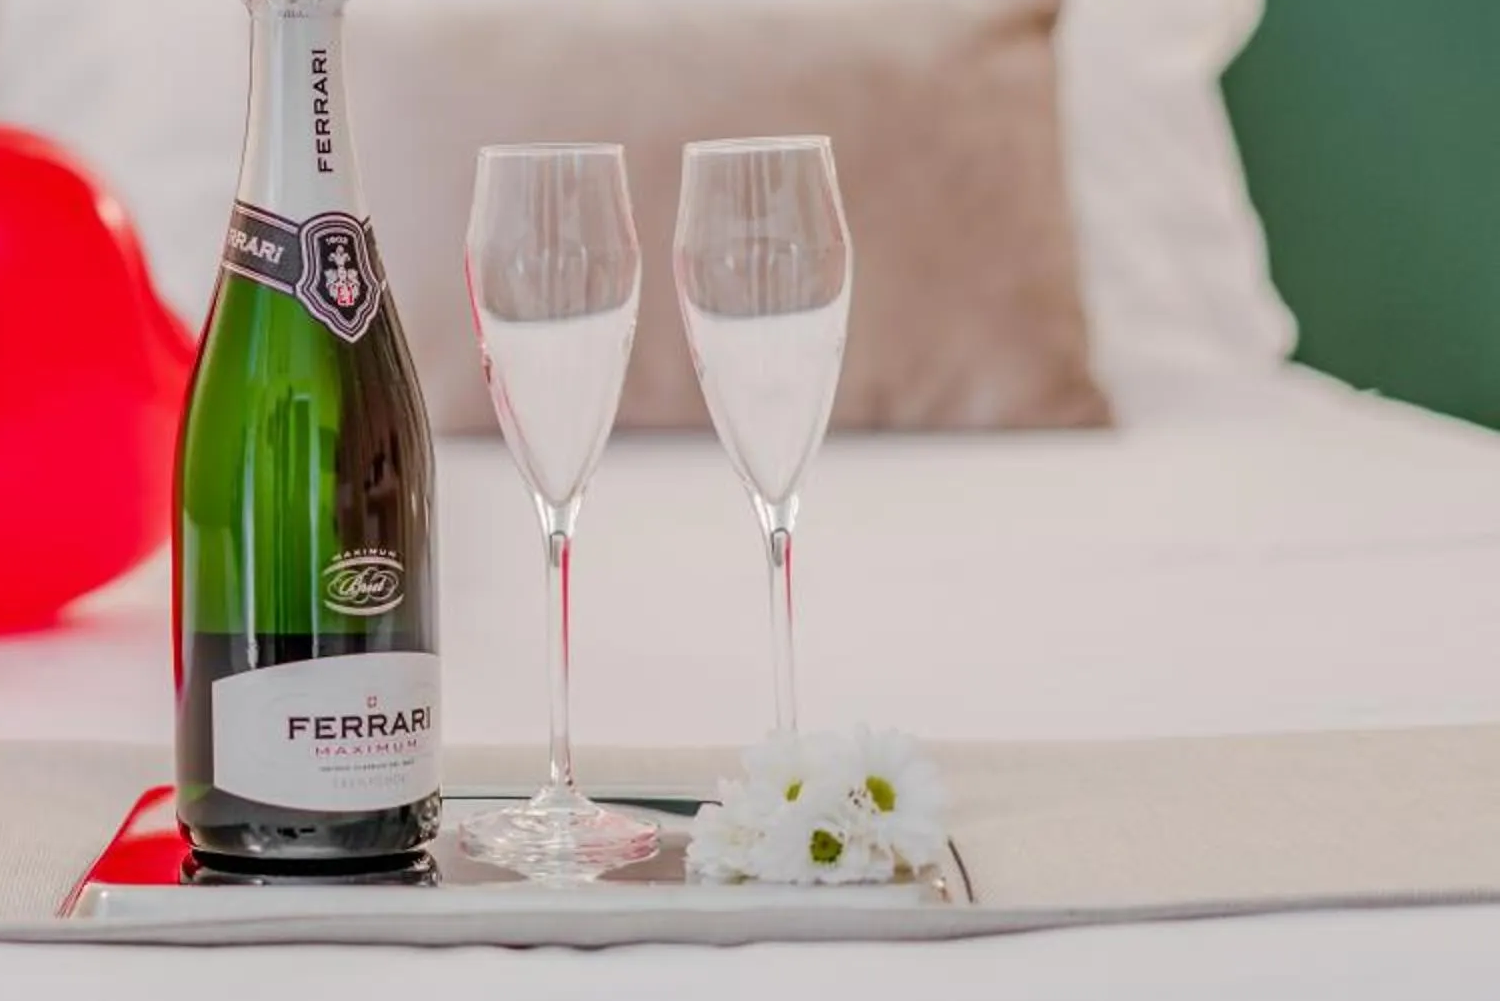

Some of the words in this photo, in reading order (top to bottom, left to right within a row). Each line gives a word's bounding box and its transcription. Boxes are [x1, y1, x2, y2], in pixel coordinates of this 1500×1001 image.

[311, 49, 334, 173] FERRARI
[288, 706, 431, 740] FERRARI
[315, 739, 417, 757] MAXIMUM
